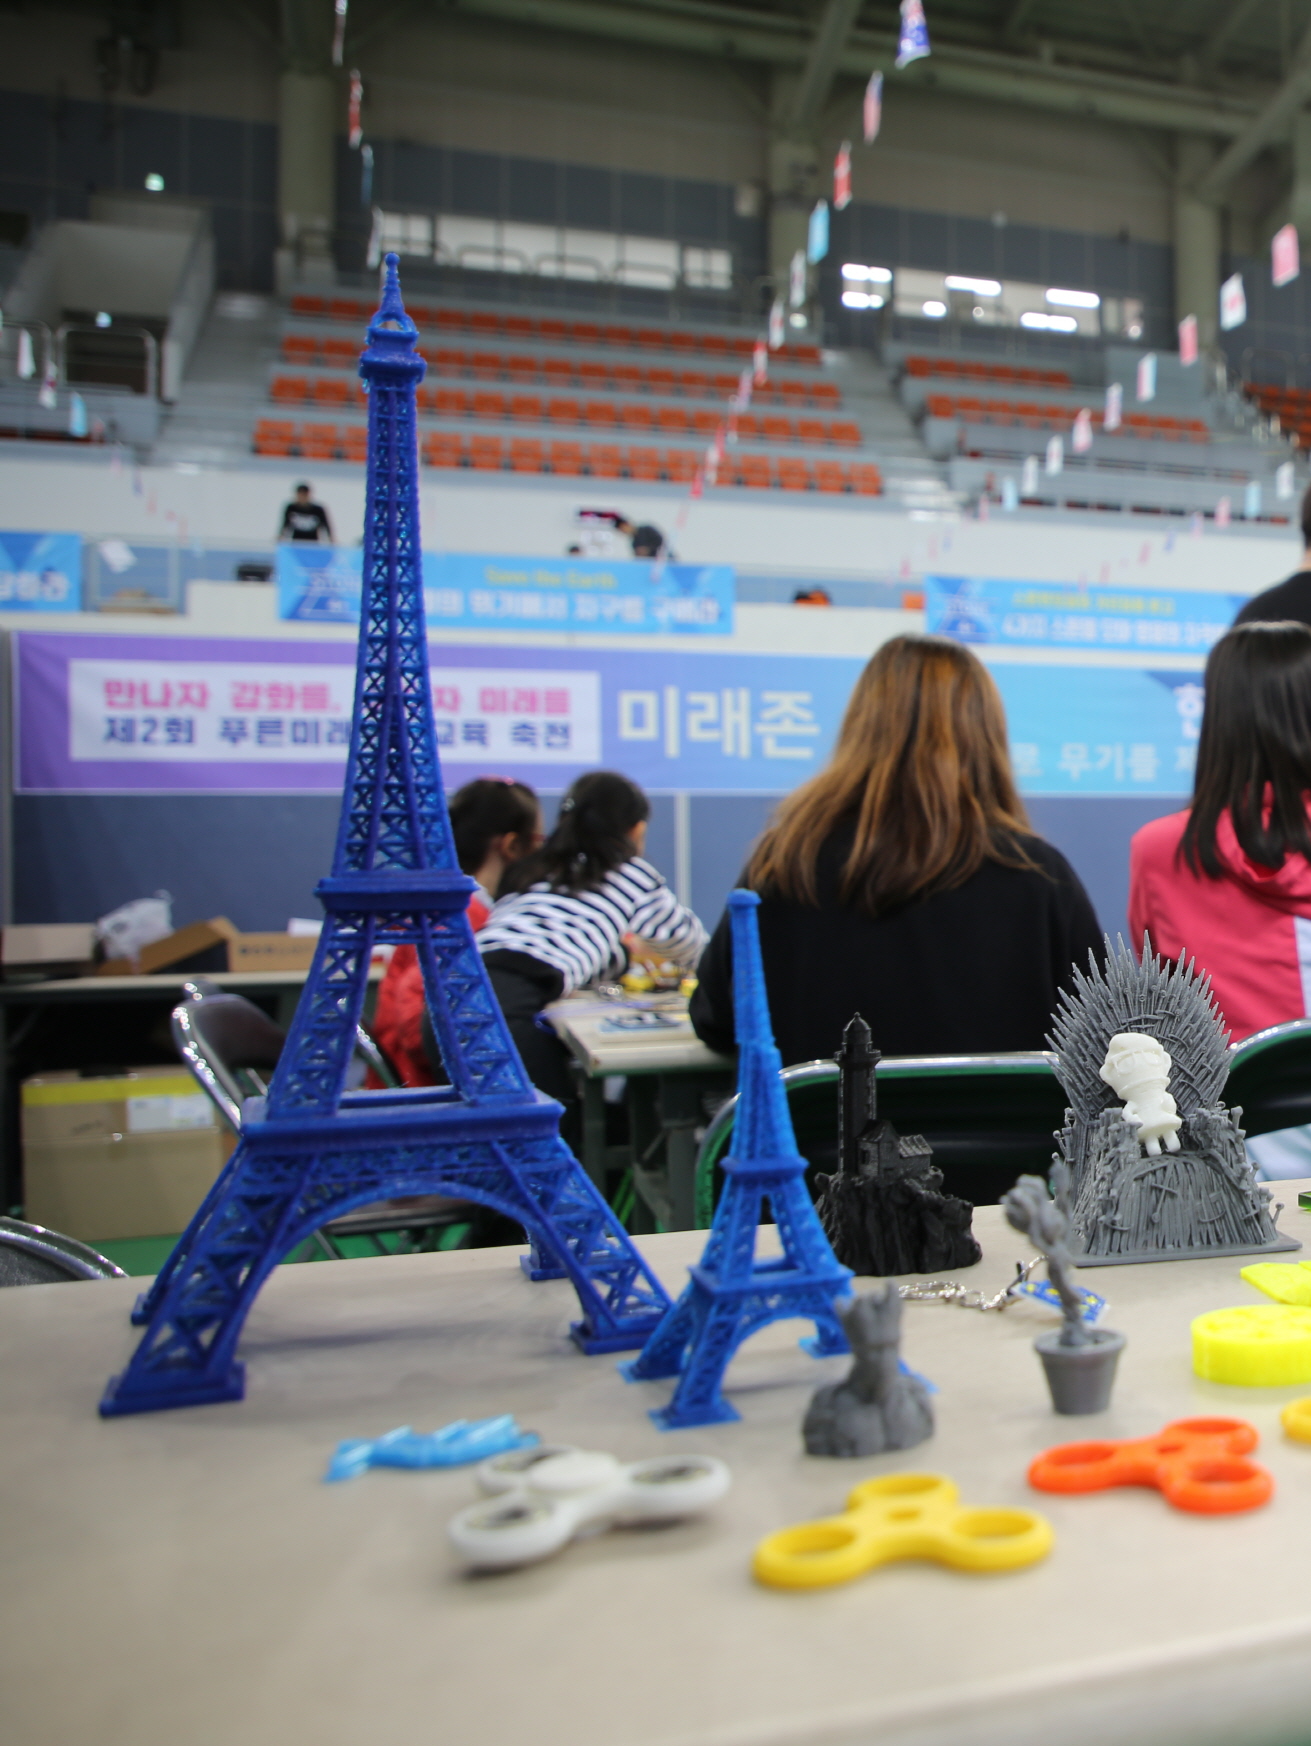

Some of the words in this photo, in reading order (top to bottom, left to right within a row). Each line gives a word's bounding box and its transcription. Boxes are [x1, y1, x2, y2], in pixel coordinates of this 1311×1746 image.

[104, 679, 209, 710] 만나자
[479, 687, 570, 715] 미래를
[103, 716, 195, 746] 제2회
[509, 718, 571, 750] 축전
[618, 684, 821, 760] 미래존
[1057, 741, 1160, 783] 무기를
